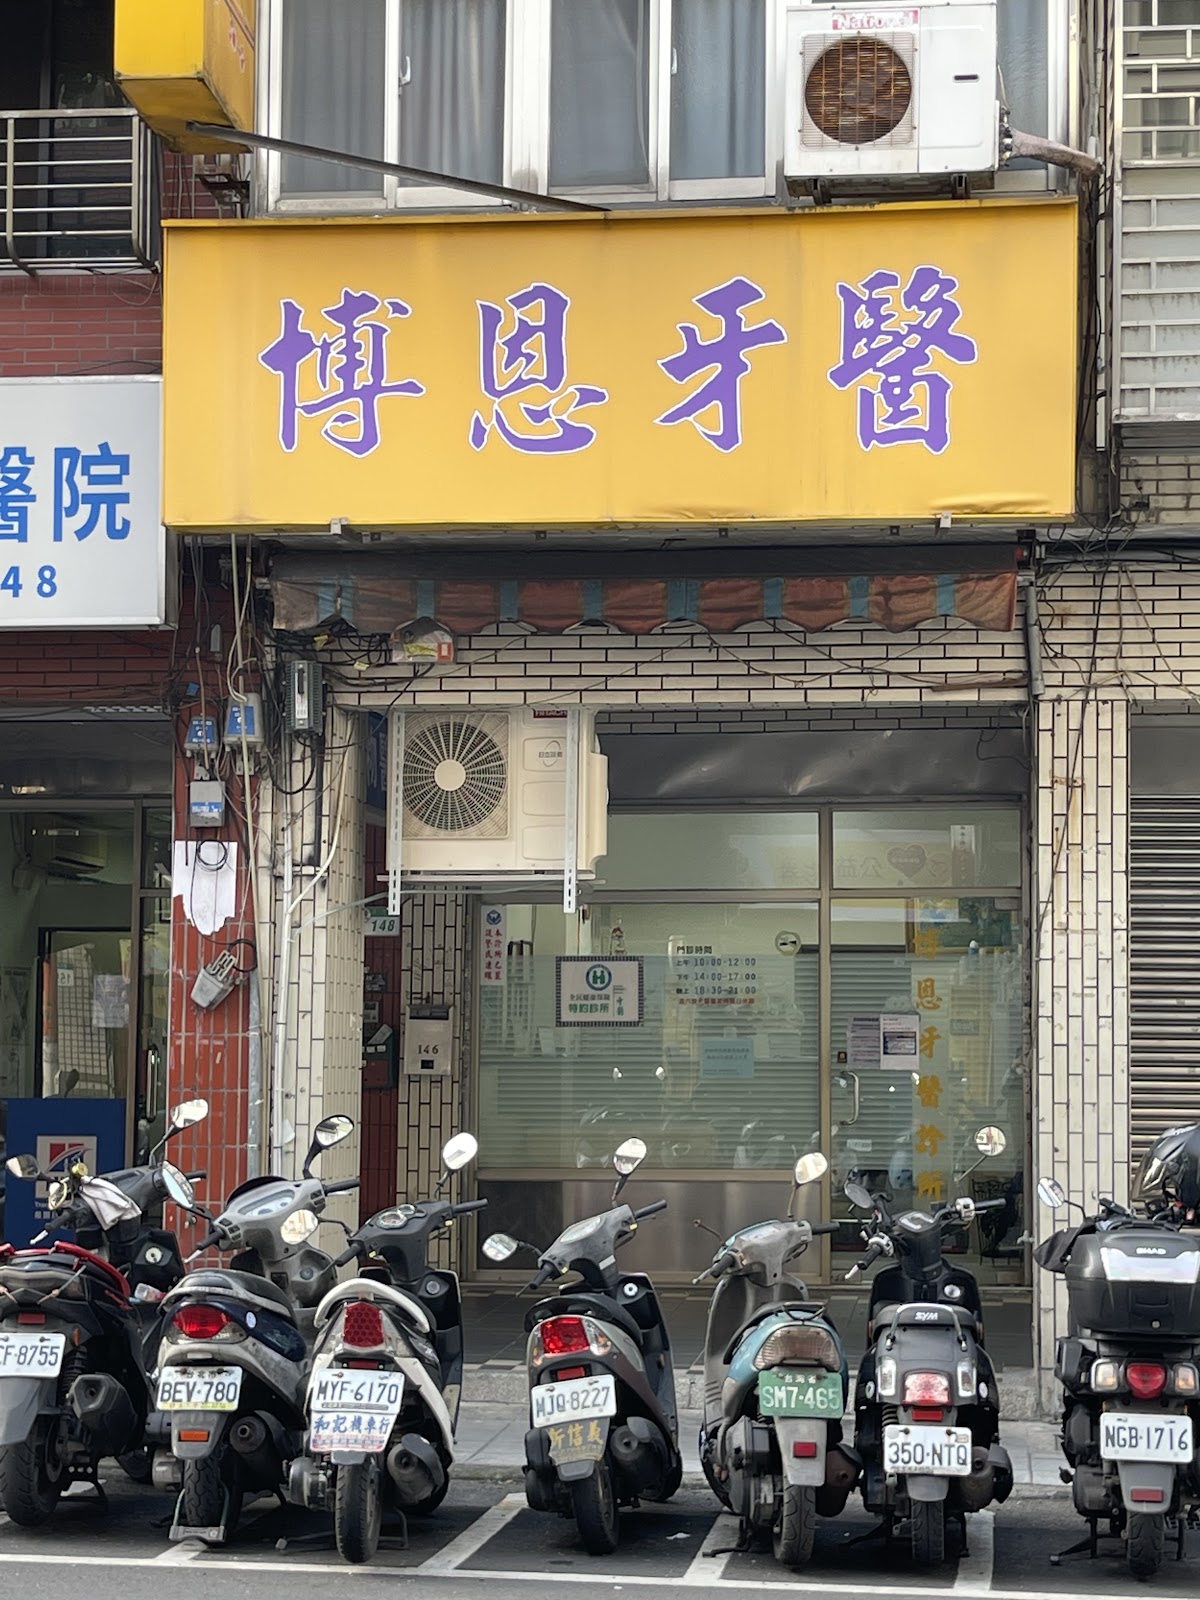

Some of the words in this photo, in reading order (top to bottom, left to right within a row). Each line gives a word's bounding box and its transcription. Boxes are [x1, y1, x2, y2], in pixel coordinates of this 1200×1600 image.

[258, 264, 978, 458] 博恩牙醫
[535, 709, 568, 718] HITACH
[371, 919, 396, 932] 148
[676, 945, 713, 955] 門診時間
[676, 959, 689, 967] 上午
[676, 974, 689, 982] 下午
[569, 1003, 610, 1014] 特約診所
[418, 1044, 439, 1055] 146
[912, 926, 946, 1201] 博恩牙醫診所
[914, 1312, 939, 1321] SYM
[314, 1414, 390, 1434] 和記機車行
